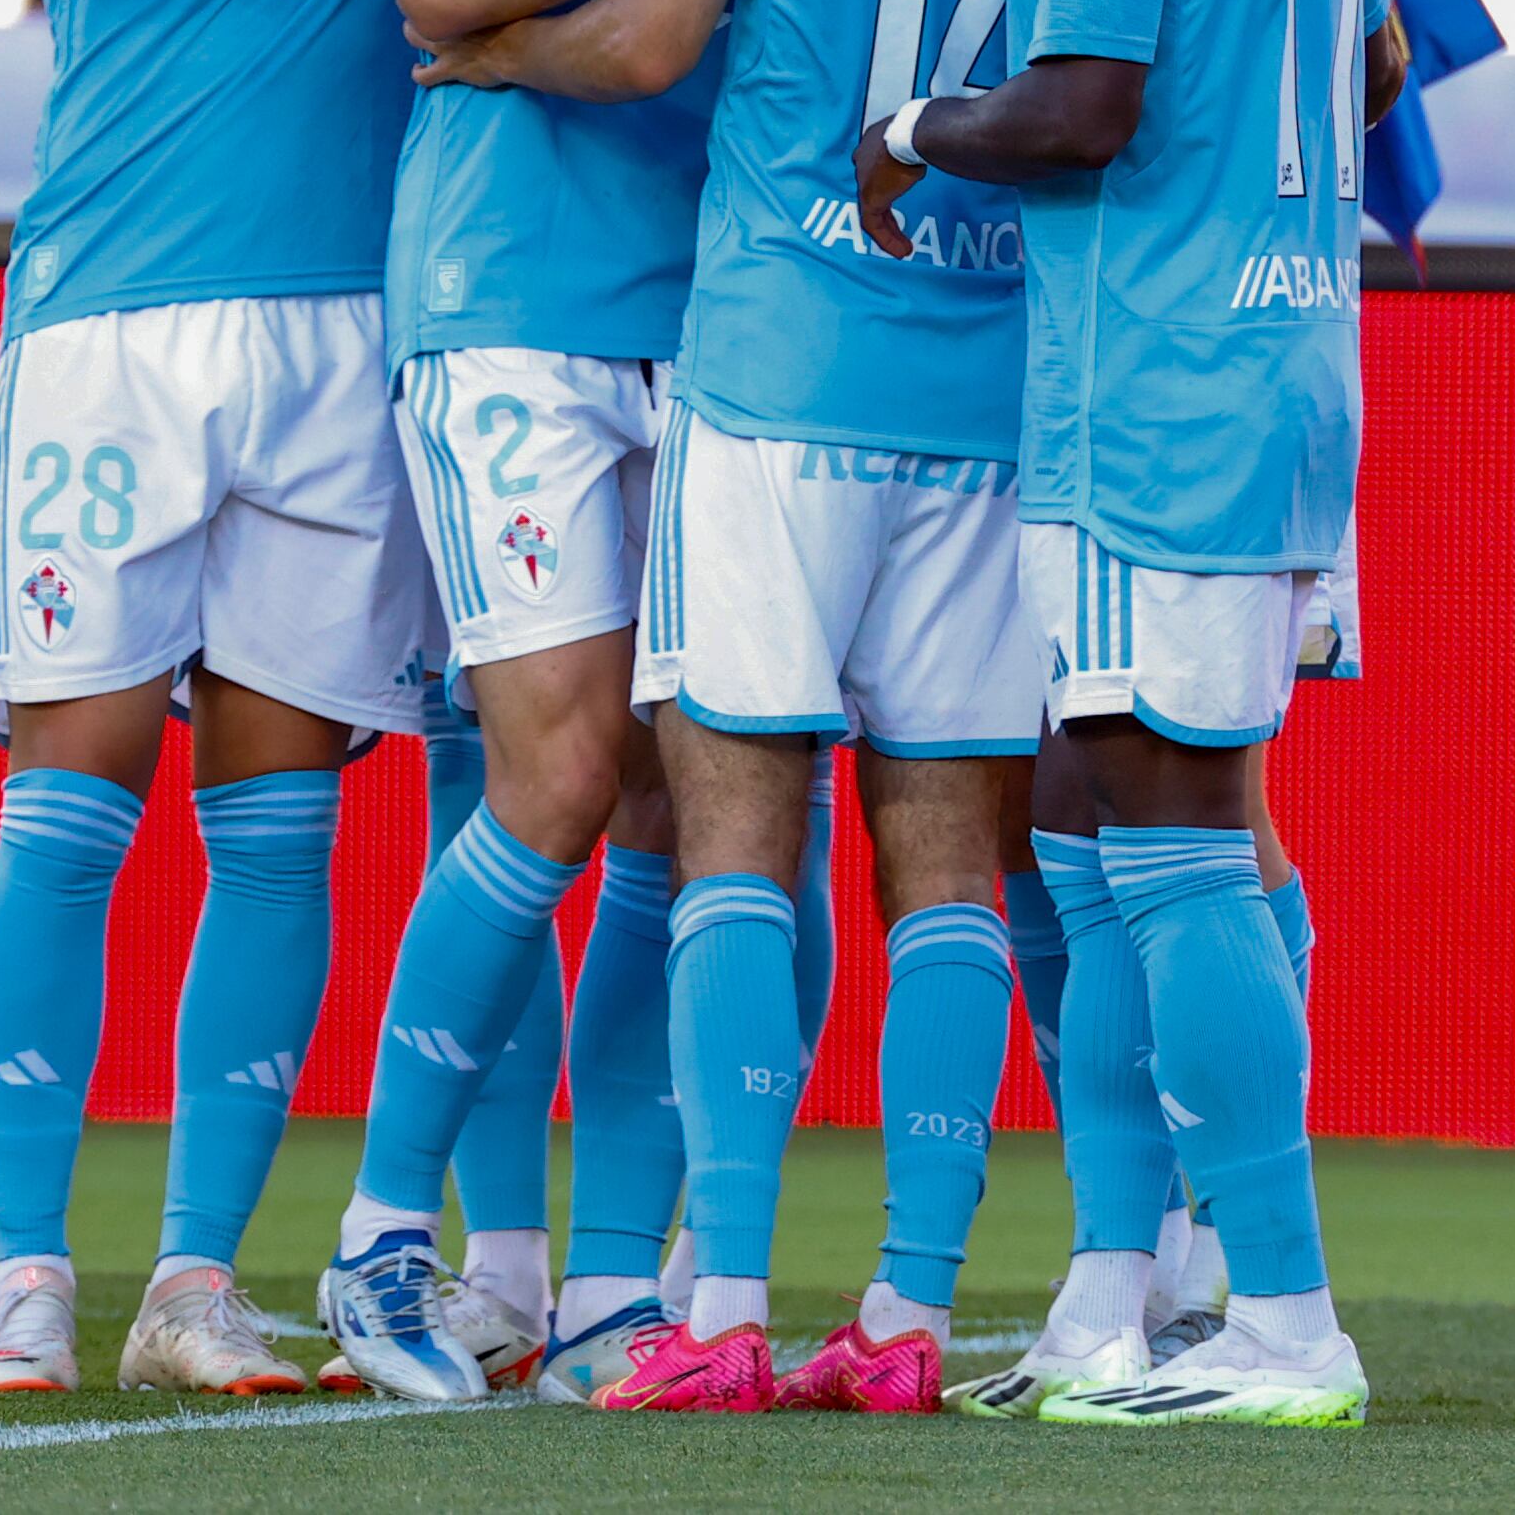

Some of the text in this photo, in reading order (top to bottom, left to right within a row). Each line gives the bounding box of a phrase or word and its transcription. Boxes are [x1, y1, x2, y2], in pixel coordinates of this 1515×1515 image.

[19, 441, 137, 550] 28
[475, 393, 540, 499] 2
[906, 1111, 985, 1147] 2023
